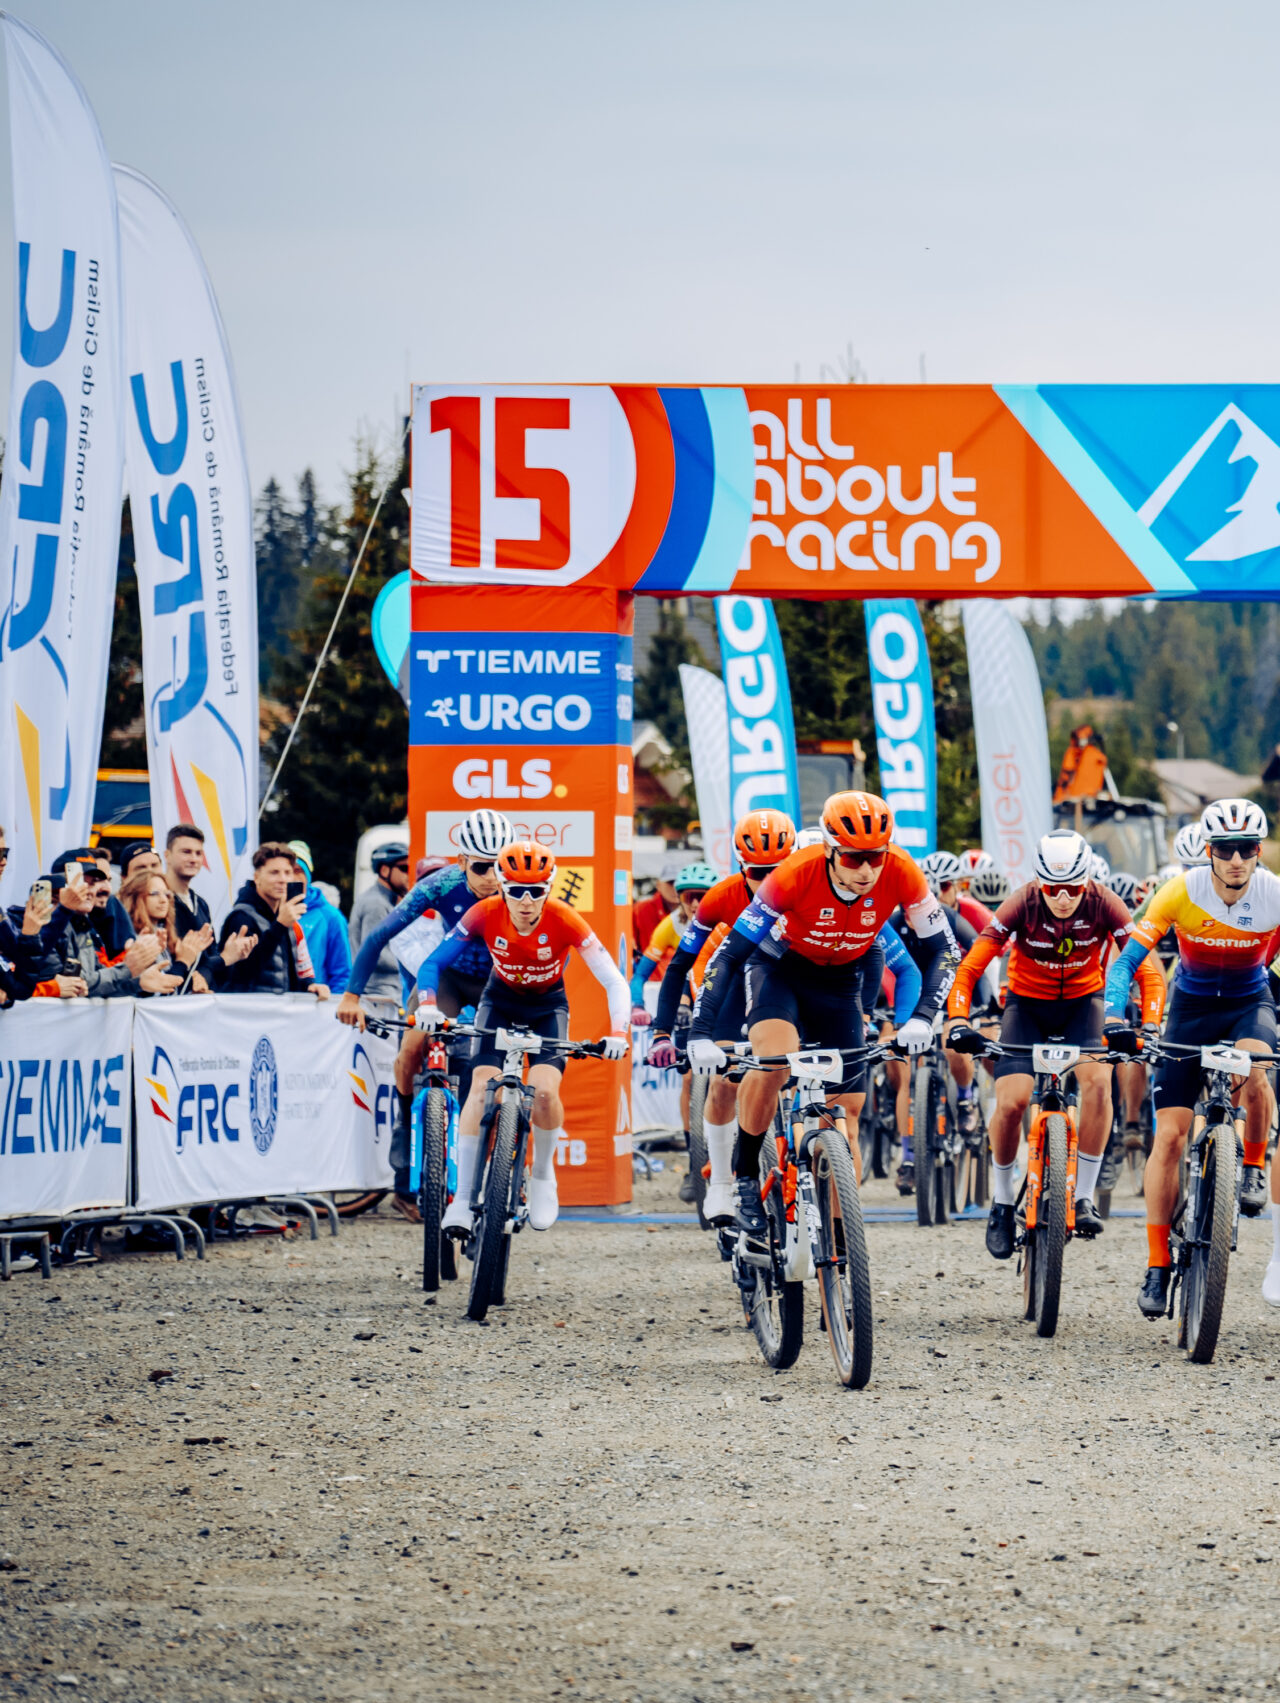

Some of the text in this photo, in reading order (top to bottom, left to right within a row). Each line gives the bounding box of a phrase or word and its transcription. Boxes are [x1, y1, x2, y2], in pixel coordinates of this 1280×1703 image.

[430, 396, 570, 570] 15
[453, 650, 601, 674] TIEMME
[460, 694, 592, 731] URGO
[0, 1055, 124, 1156] IEMME
[176, 1083, 239, 1148] FRC
